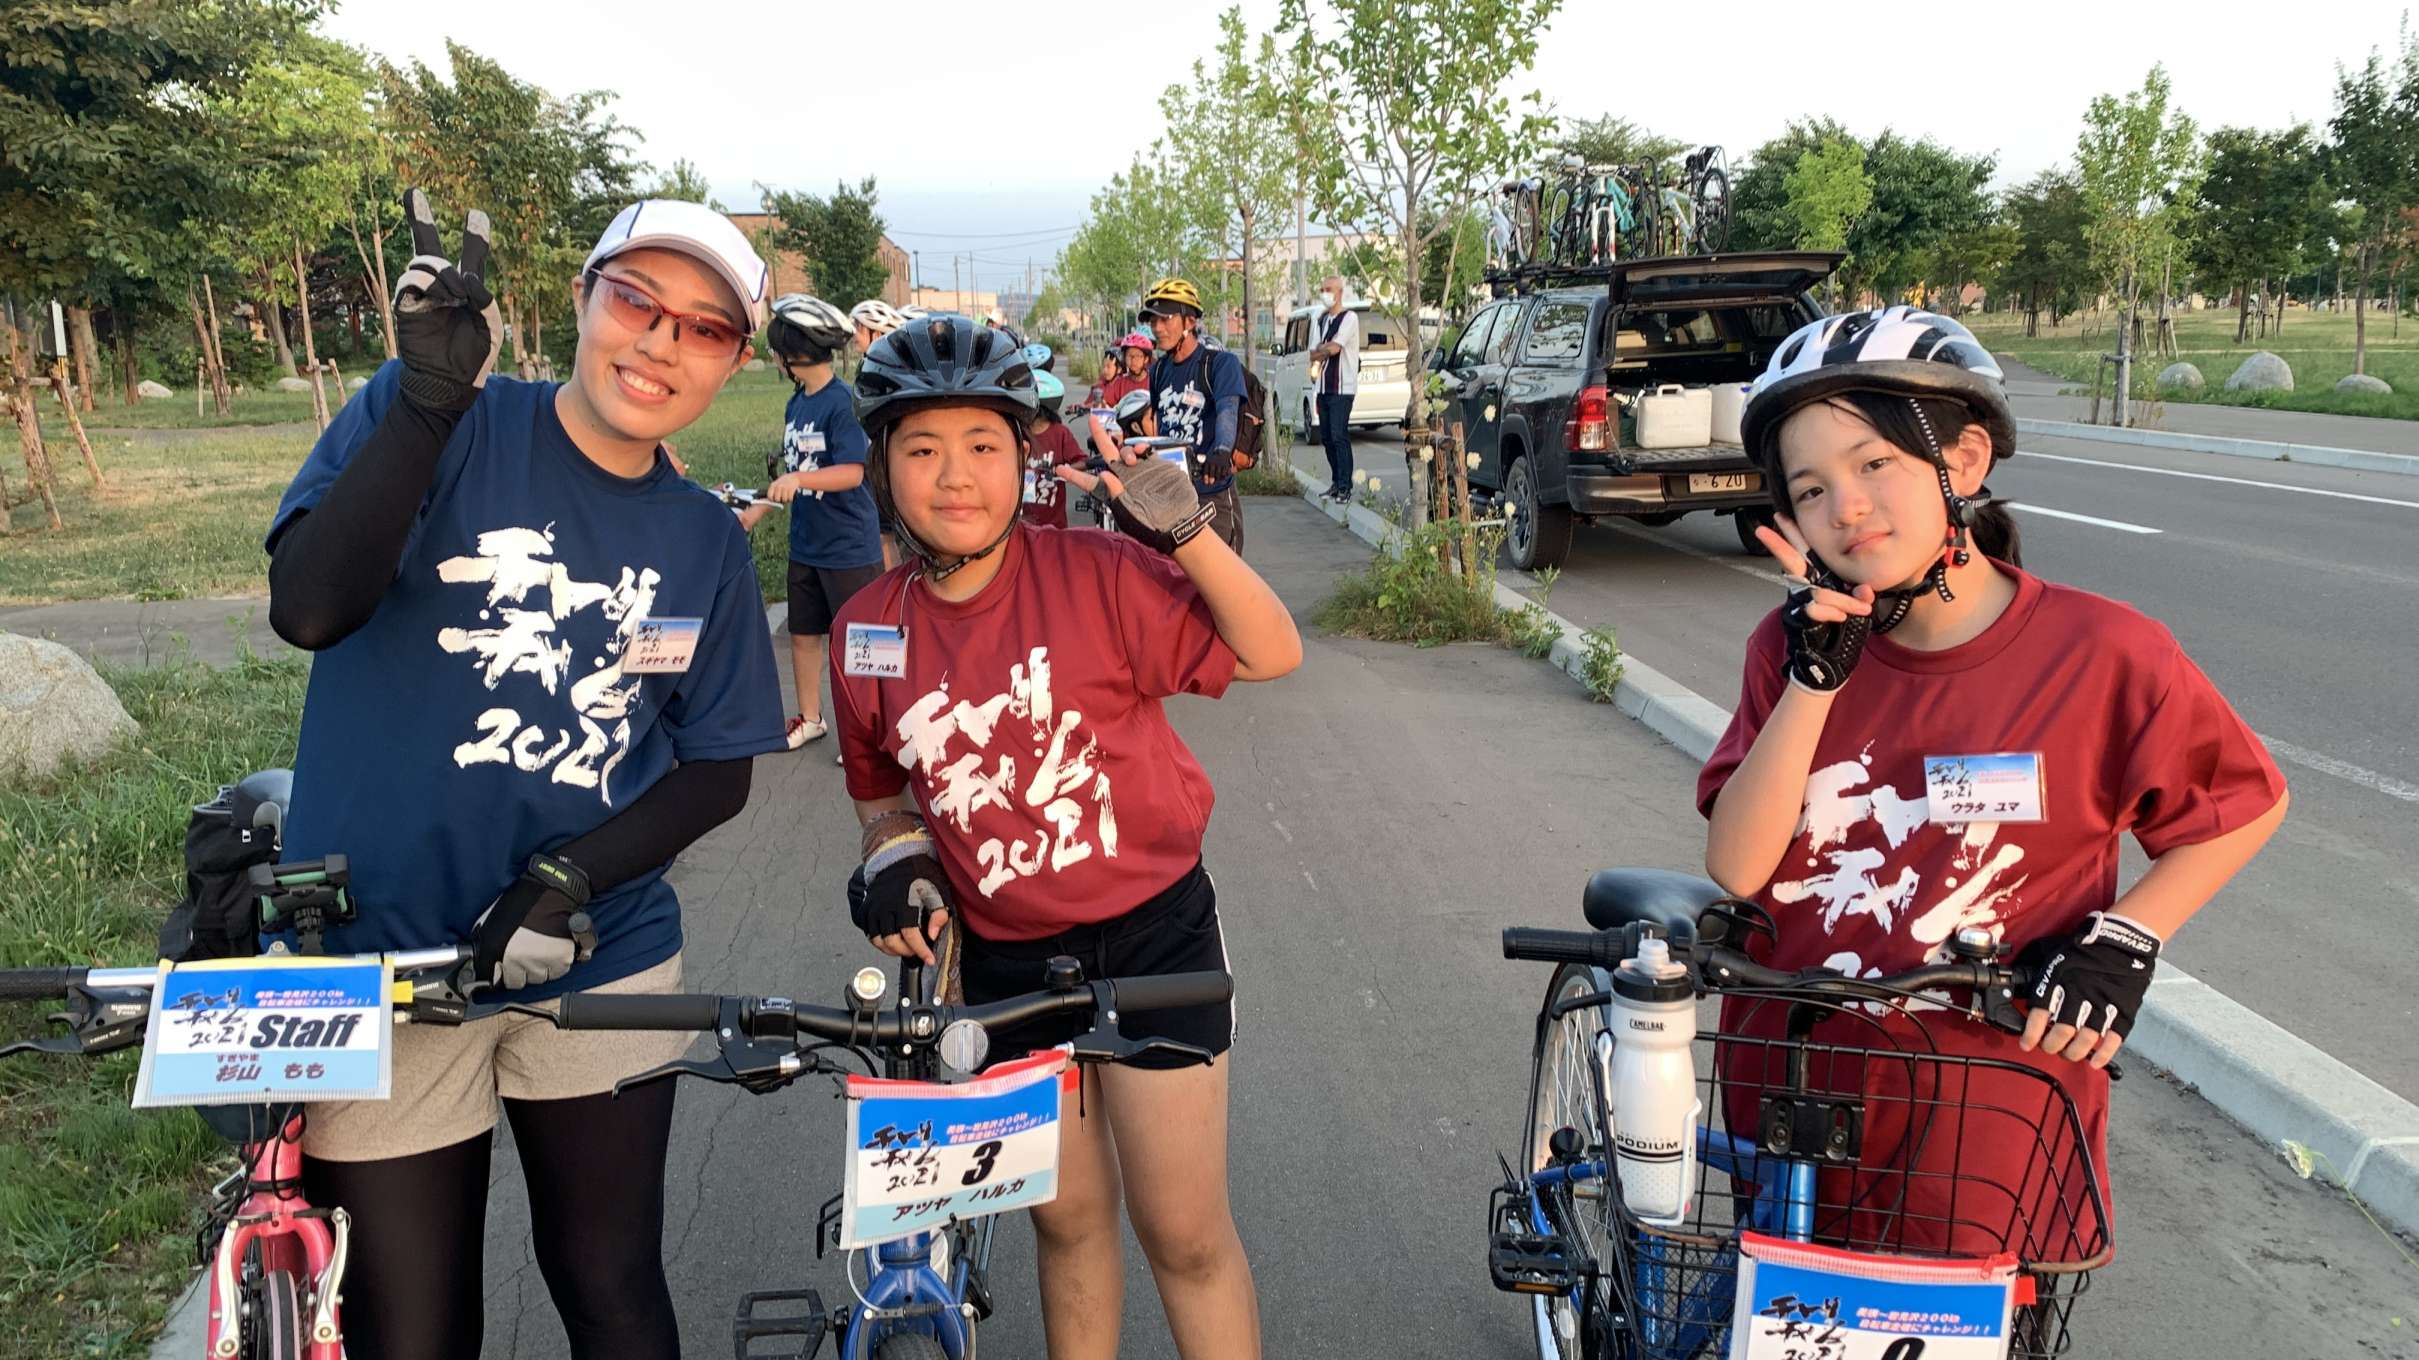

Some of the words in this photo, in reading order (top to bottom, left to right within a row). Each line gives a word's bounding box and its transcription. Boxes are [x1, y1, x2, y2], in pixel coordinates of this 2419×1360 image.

[453, 708, 632, 808] 2021
[1951, 802, 1986, 814] ウラタ
[1993, 802, 2020, 812] ユマ
[976, 771, 1118, 898] 2021
[2035, 953, 2066, 998] CEVAPRO
[188, 1022, 248, 1048] 2021
[250, 1013, 362, 1049] Staff
[215, 1063, 262, 1082] 杉山
[284, 1061, 325, 1080] もも
[1616, 1133, 1680, 1151] PODIUM
[886, 1161, 940, 1192] 2021
[961, 1141, 1003, 1186] 3
[892, 1196, 953, 1222] アツヤ
[968, 1178, 1026, 1202] ハルカ
